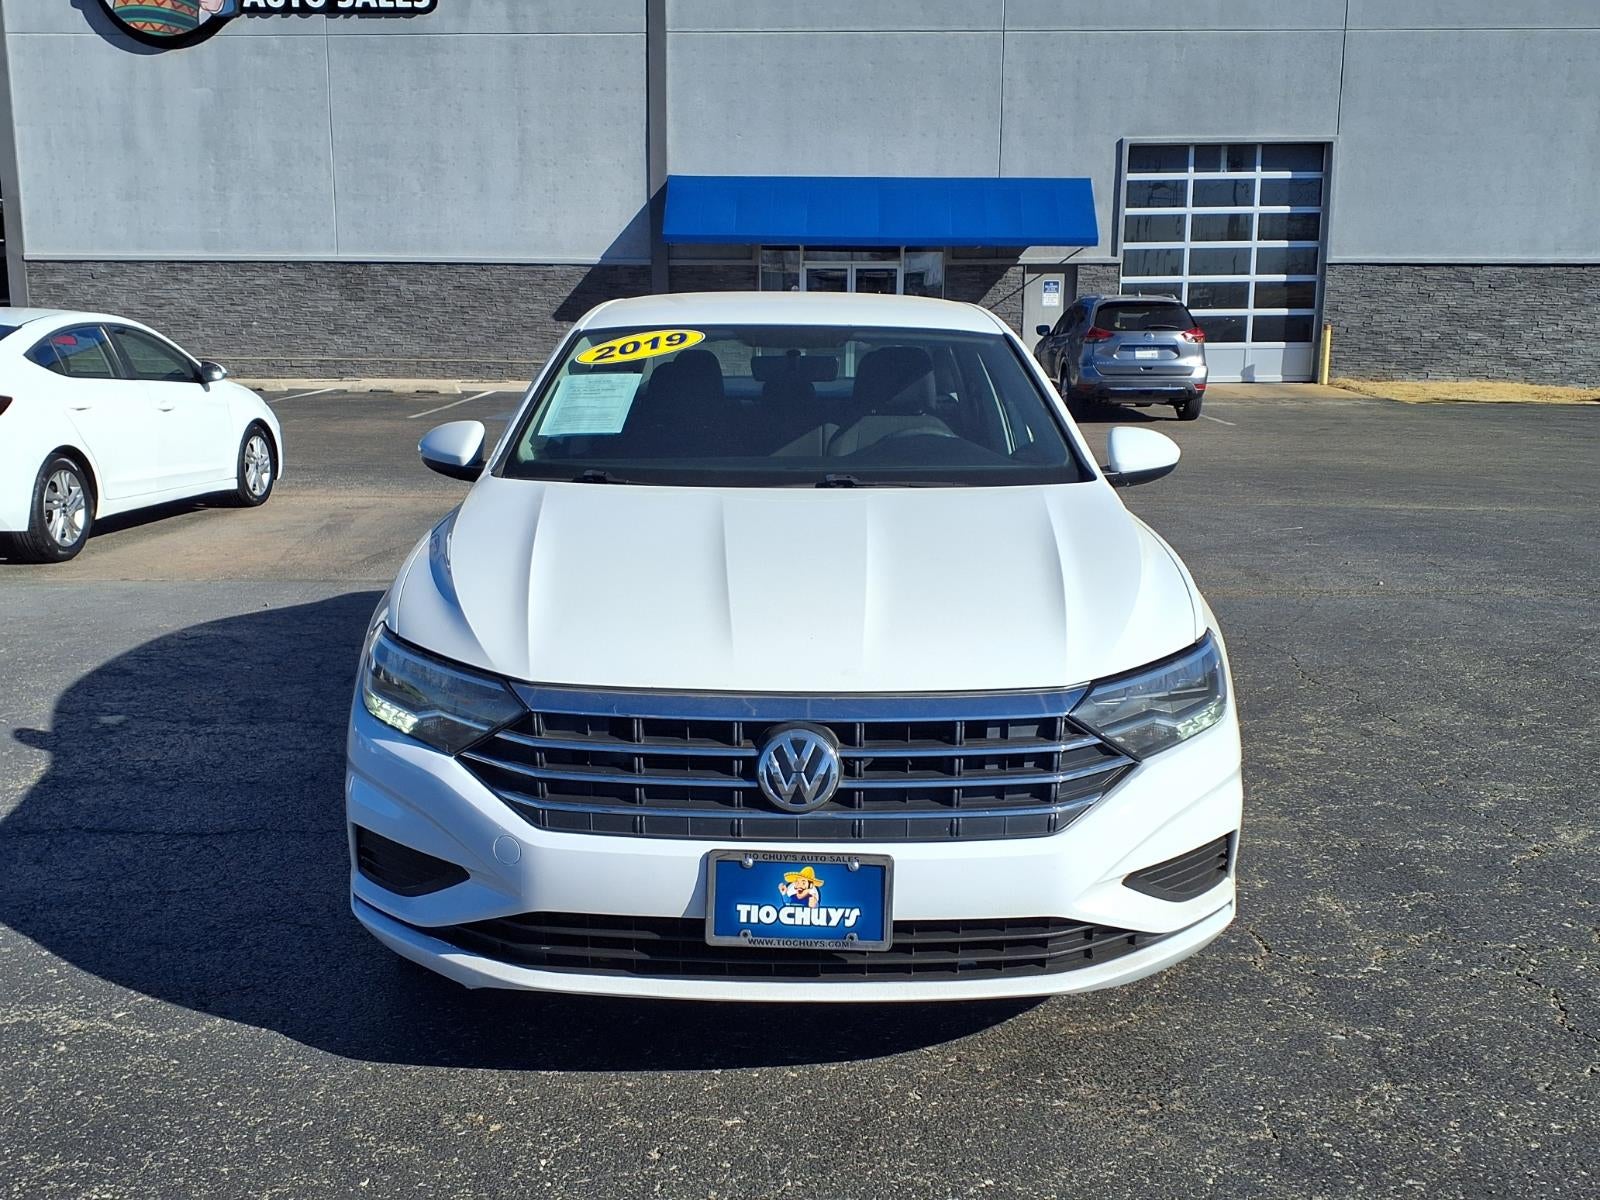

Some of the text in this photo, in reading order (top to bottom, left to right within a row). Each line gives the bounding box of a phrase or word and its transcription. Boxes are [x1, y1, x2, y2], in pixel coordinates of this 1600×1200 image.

[592, 333, 688, 361] 2019
[743, 852, 759, 860] TIO
[762, 853, 798, 861] CHUY'S
[747, 938, 851, 949] WWW.TIOCHUYS.COM
